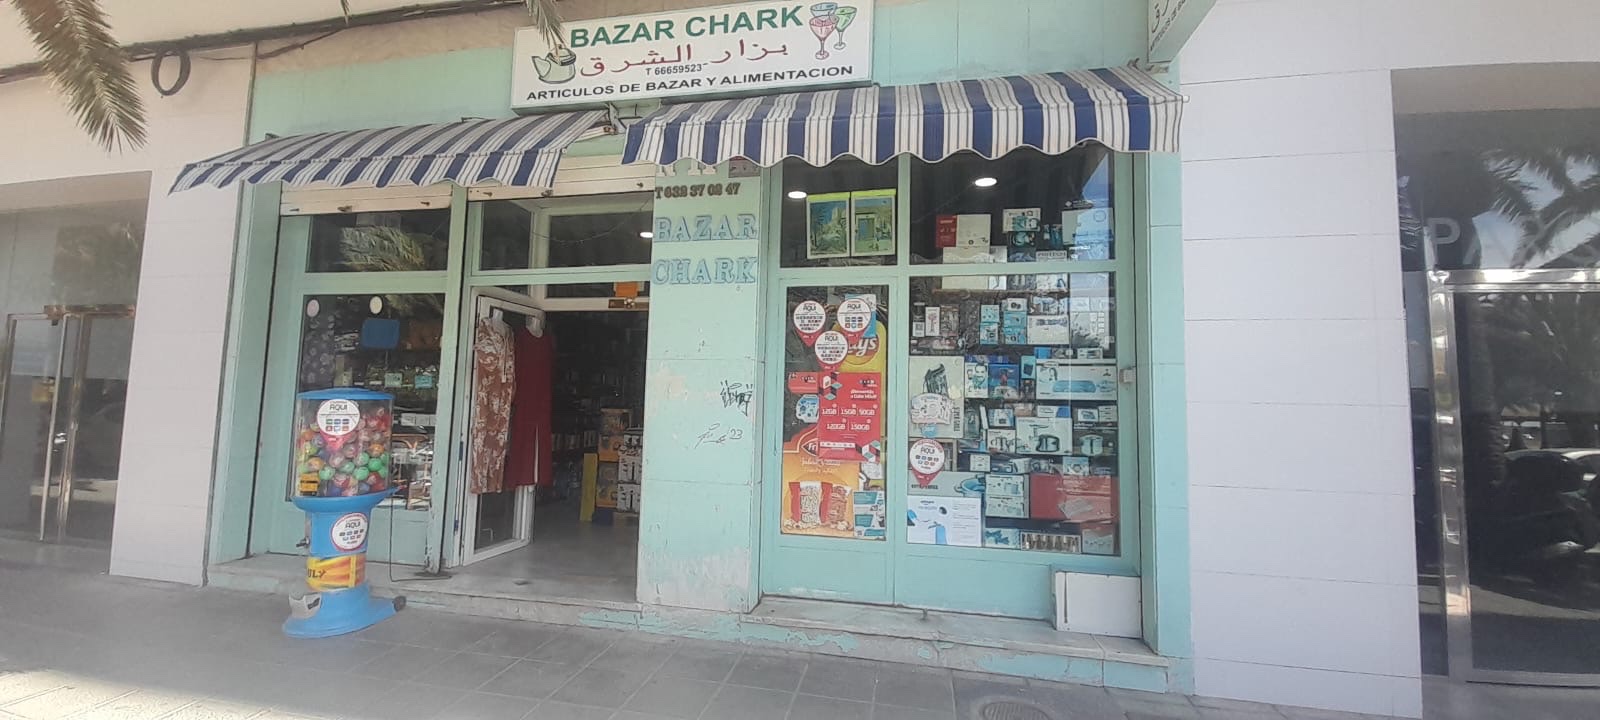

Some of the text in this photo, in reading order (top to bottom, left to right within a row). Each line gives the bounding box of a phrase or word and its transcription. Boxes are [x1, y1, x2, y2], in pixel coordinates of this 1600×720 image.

[570, 5, 804, 49] BAZAR CHARK
[580, 38, 789, 77] بزار الشرق
[645, 62, 709, 76] T 66659523
[526, 65, 853, 101] ARTICULOS DE BAZAR Y ALIMENTACION
[654, 213, 758, 242] BAZAR
[652, 256, 758, 285] CHARK
